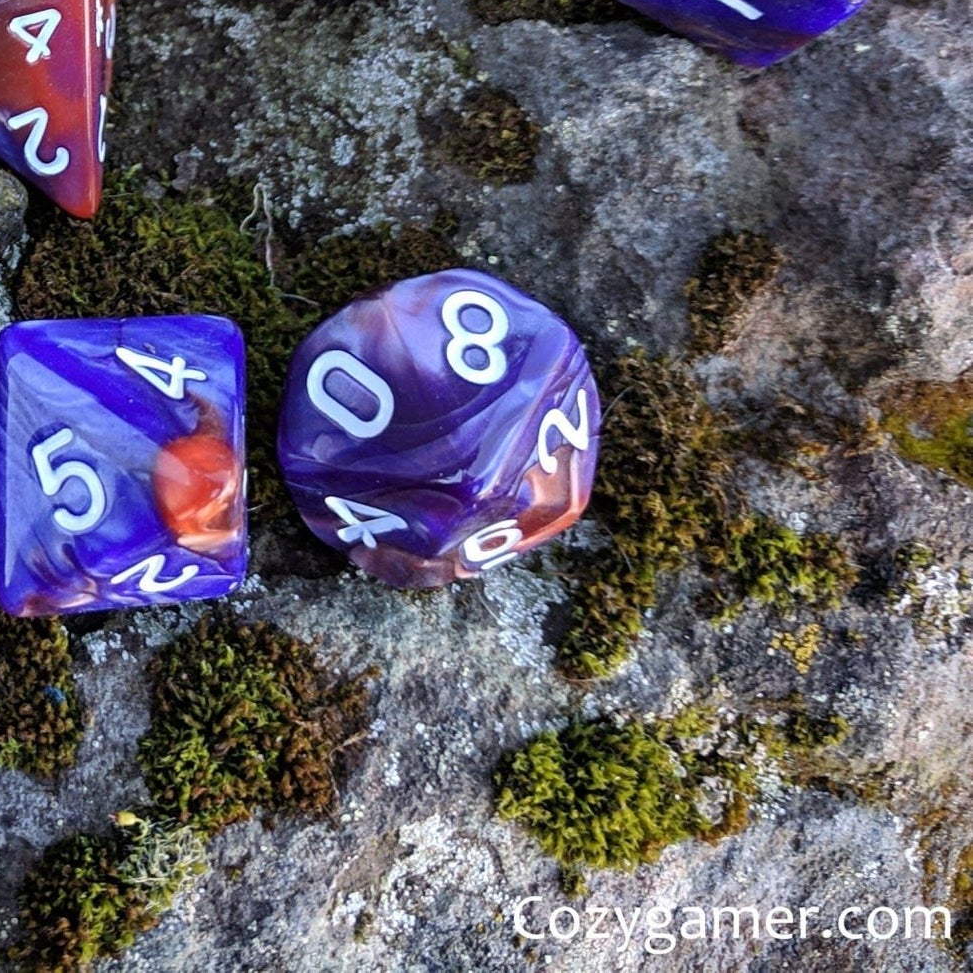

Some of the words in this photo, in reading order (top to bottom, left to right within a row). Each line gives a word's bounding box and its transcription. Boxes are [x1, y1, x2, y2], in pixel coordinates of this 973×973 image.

[8, 8, 63, 65] 4
[7, 107, 71, 175] 2
[442, 289, 509, 385] 8
[115, 347, 208, 401] 4
[306, 349, 395, 439] 0
[538, 388, 589, 476] 2
[32, 427, 107, 532] 5
[324, 496, 409, 549] 4
[110, 553, 200, 593] 2
